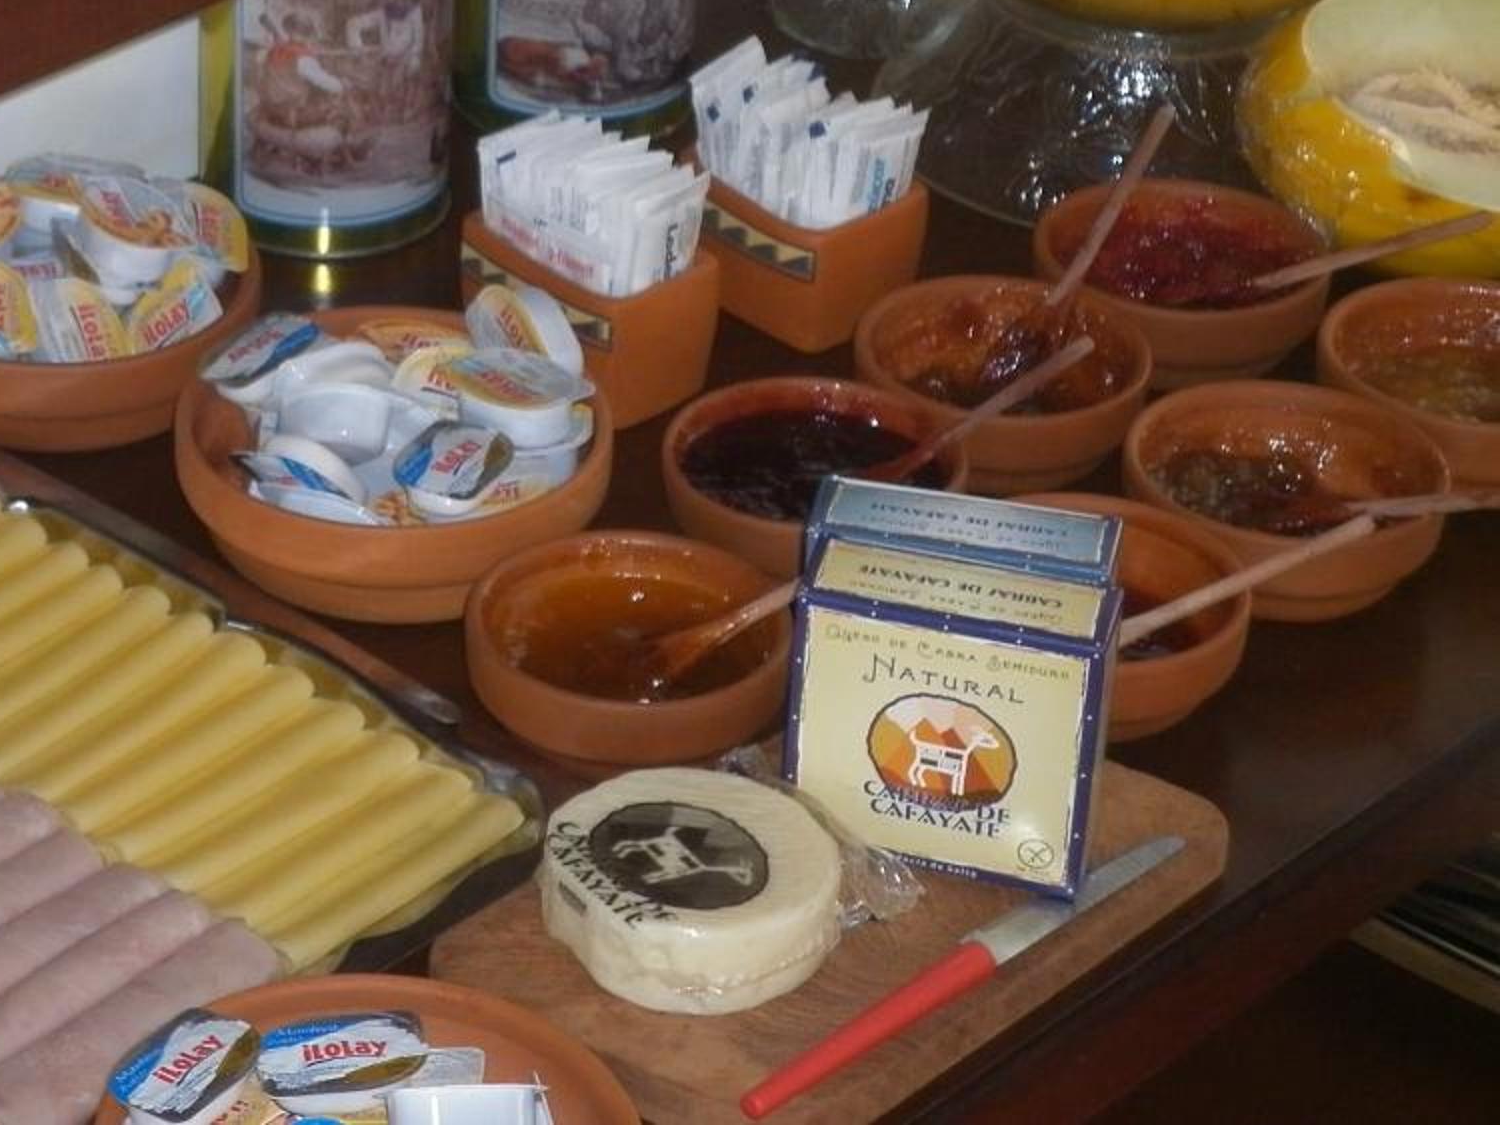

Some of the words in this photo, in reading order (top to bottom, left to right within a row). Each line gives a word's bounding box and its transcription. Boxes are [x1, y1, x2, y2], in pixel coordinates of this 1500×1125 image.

[860, 564, 951, 589] CAFAYATE
[959, 582, 981, 596] DE
[862, 653, 1025, 704] NATURAL
[870, 798, 1002, 837] CAFAYATE
[976, 805, 1012, 824] DE
